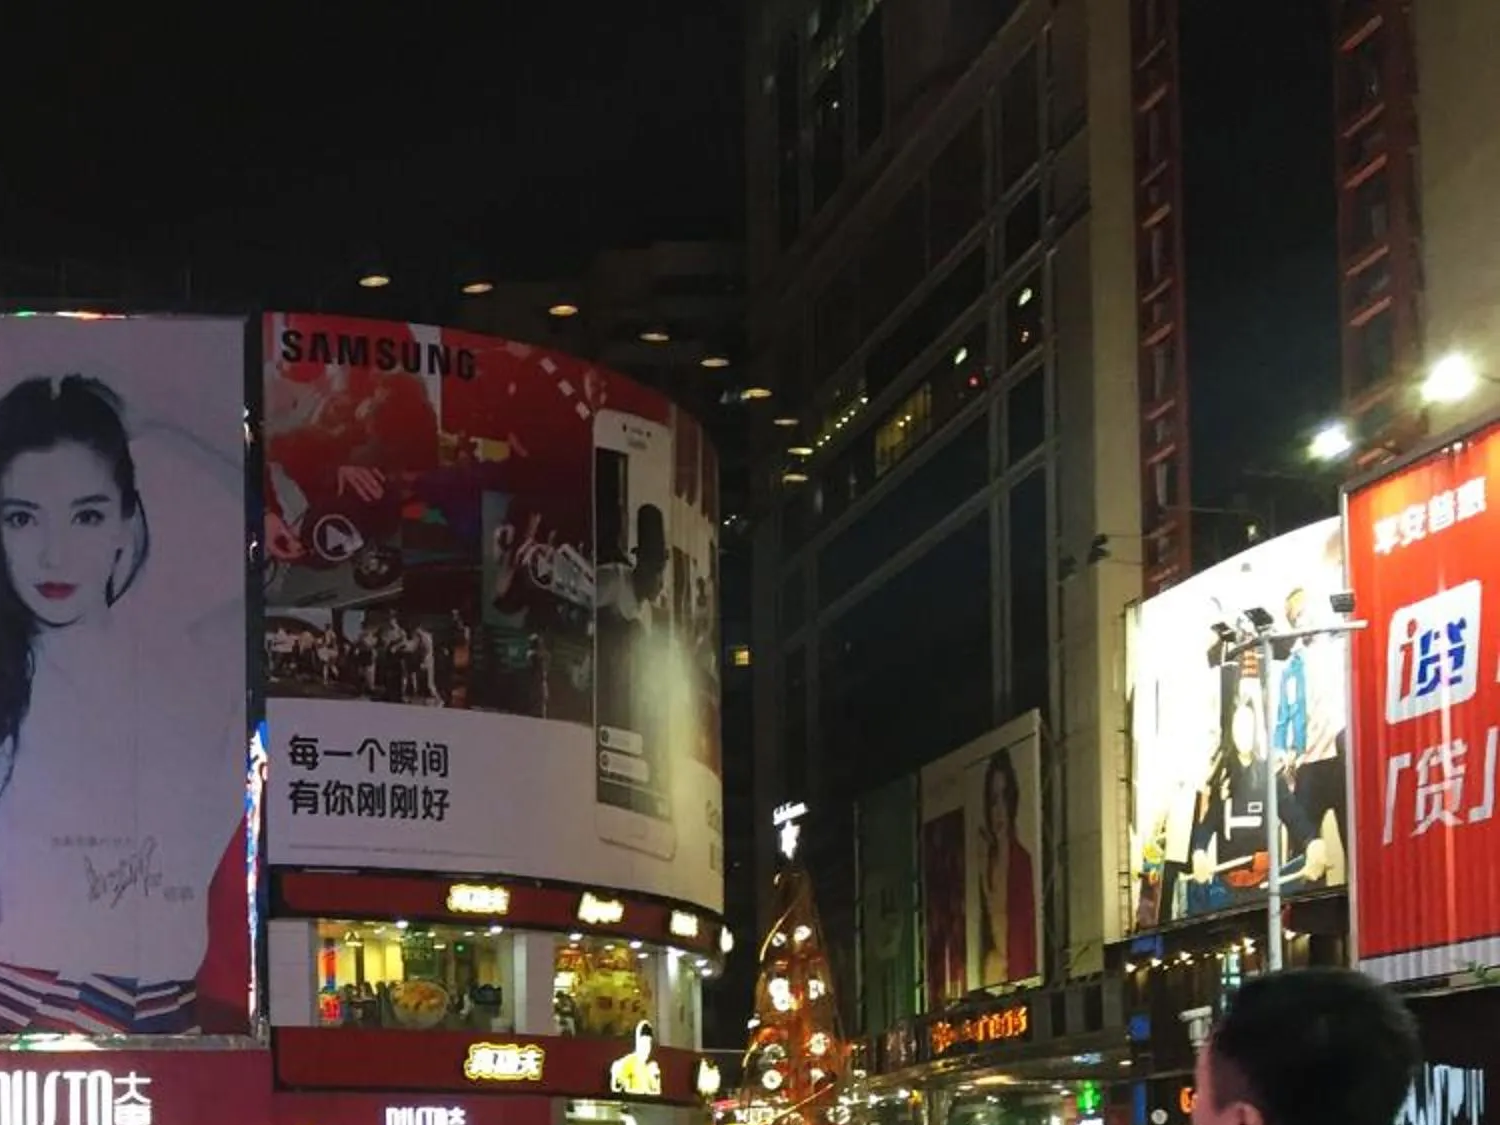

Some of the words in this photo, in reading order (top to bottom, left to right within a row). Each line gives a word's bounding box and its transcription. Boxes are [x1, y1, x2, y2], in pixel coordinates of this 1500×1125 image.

[282, 329, 476, 381] SAMSUNG
[288, 734, 450, 778] 每一个瞬间
[288, 780, 450, 822] 有你刚刚好
